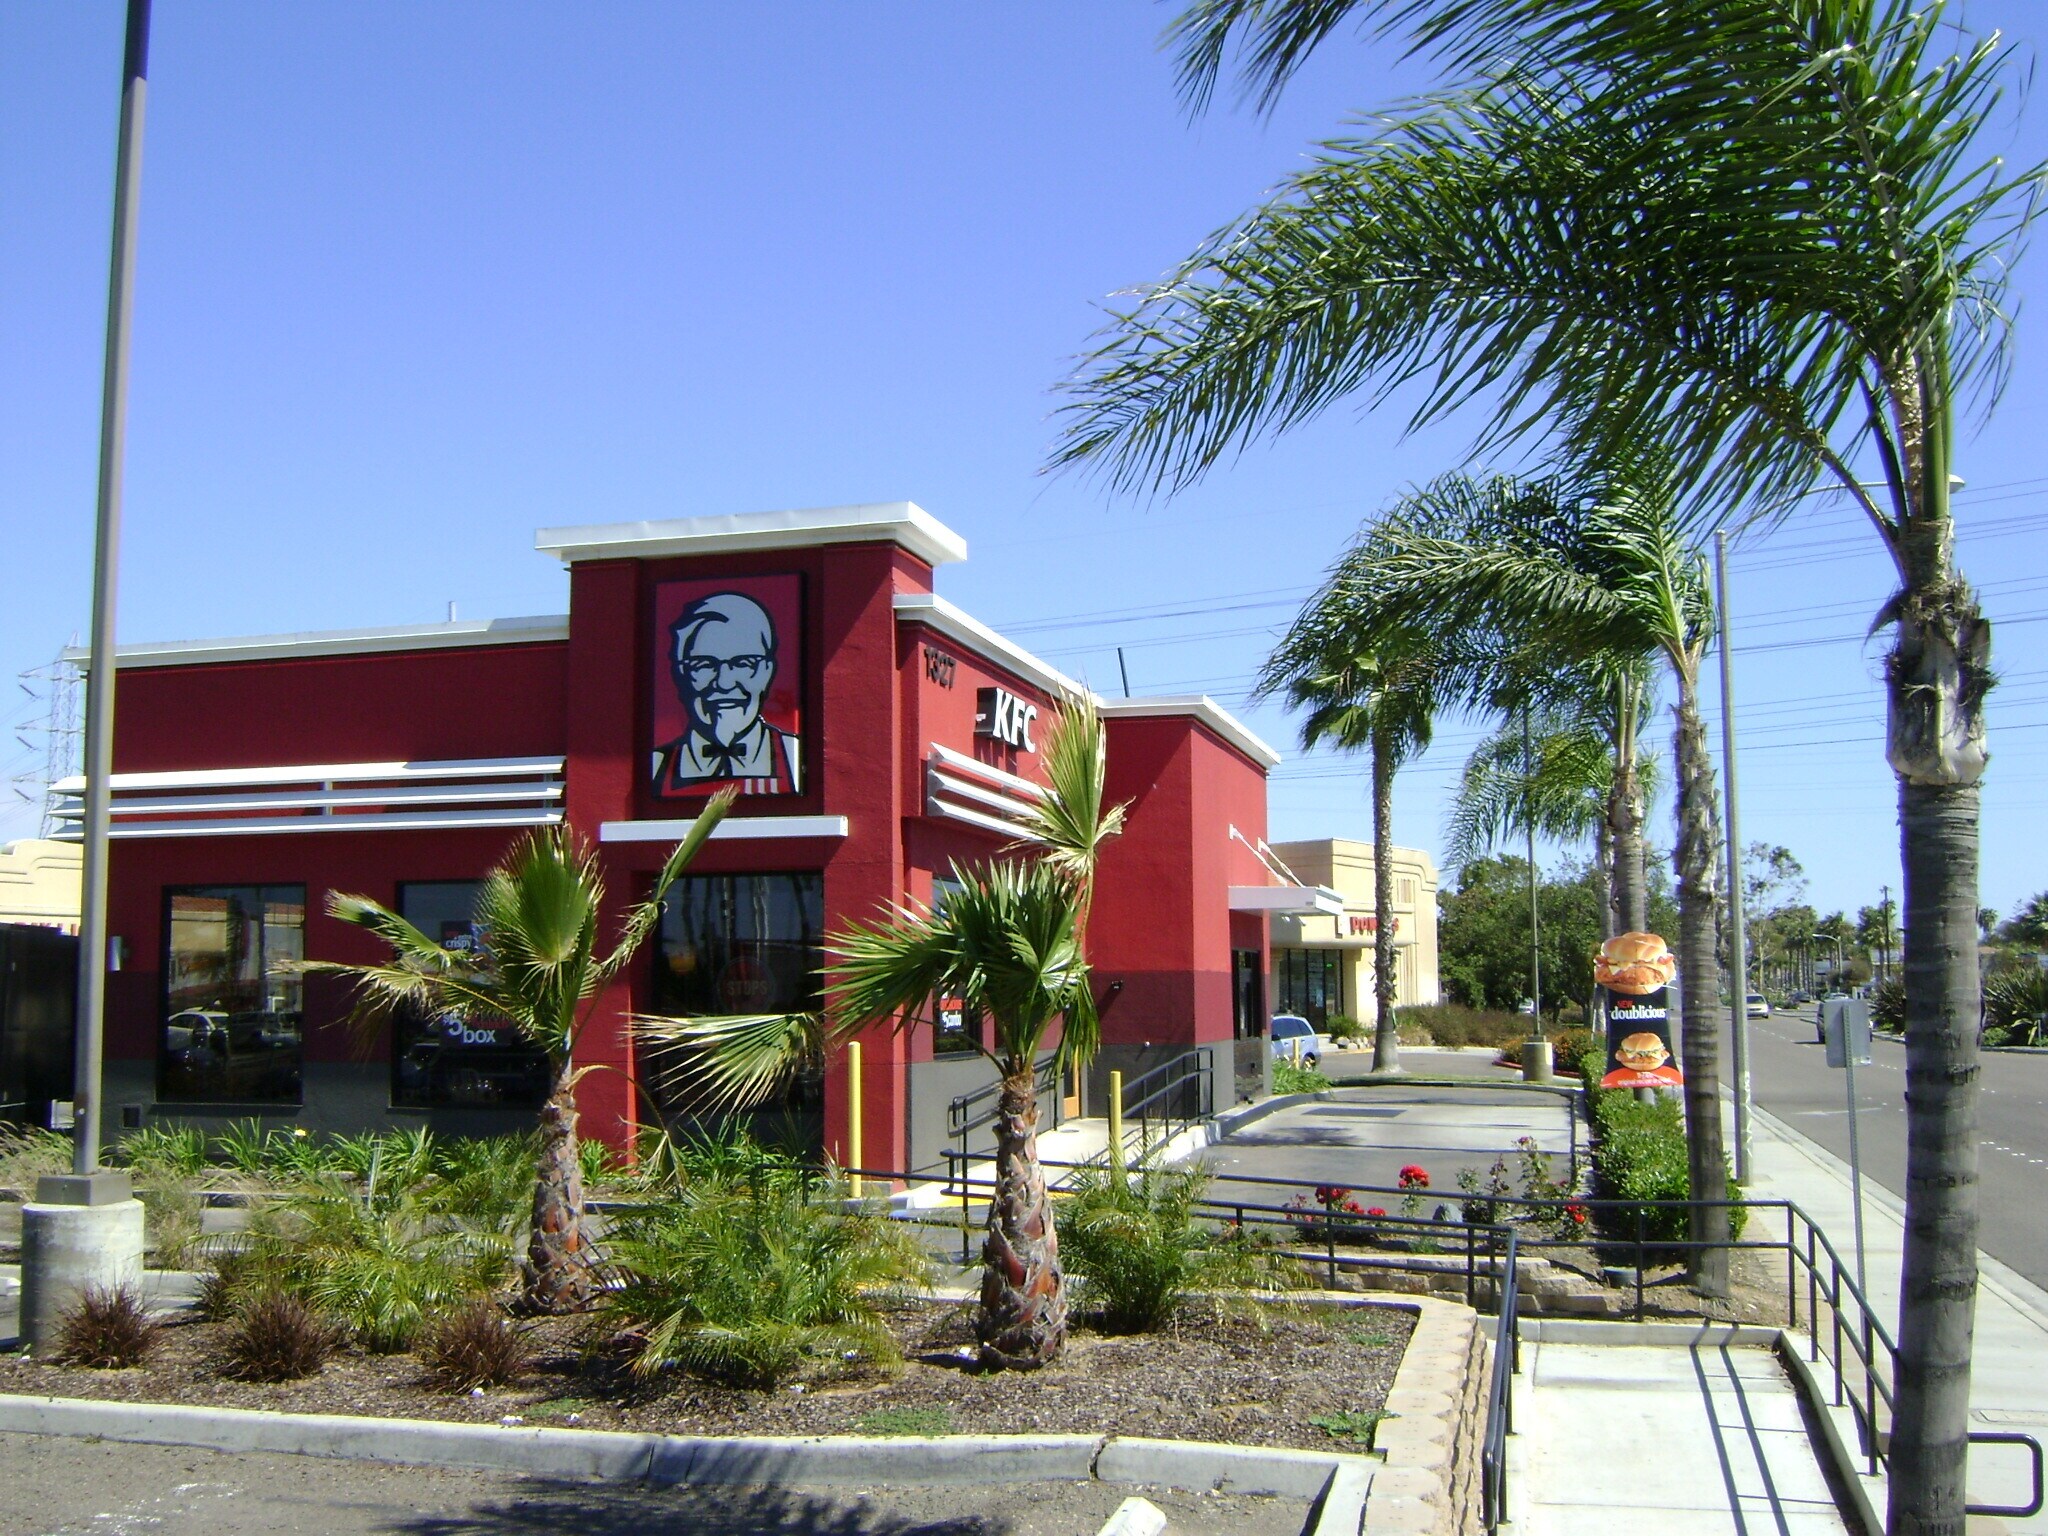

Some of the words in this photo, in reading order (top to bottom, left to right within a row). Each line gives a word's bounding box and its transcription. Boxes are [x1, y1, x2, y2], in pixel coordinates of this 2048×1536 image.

[924, 646, 957, 691] 1327
[992, 687, 1037, 754] KFC
[445, 936, 471, 951] crispy
[1611, 1004, 1666, 1020] doublicious
[463, 1025, 496, 1043] box
